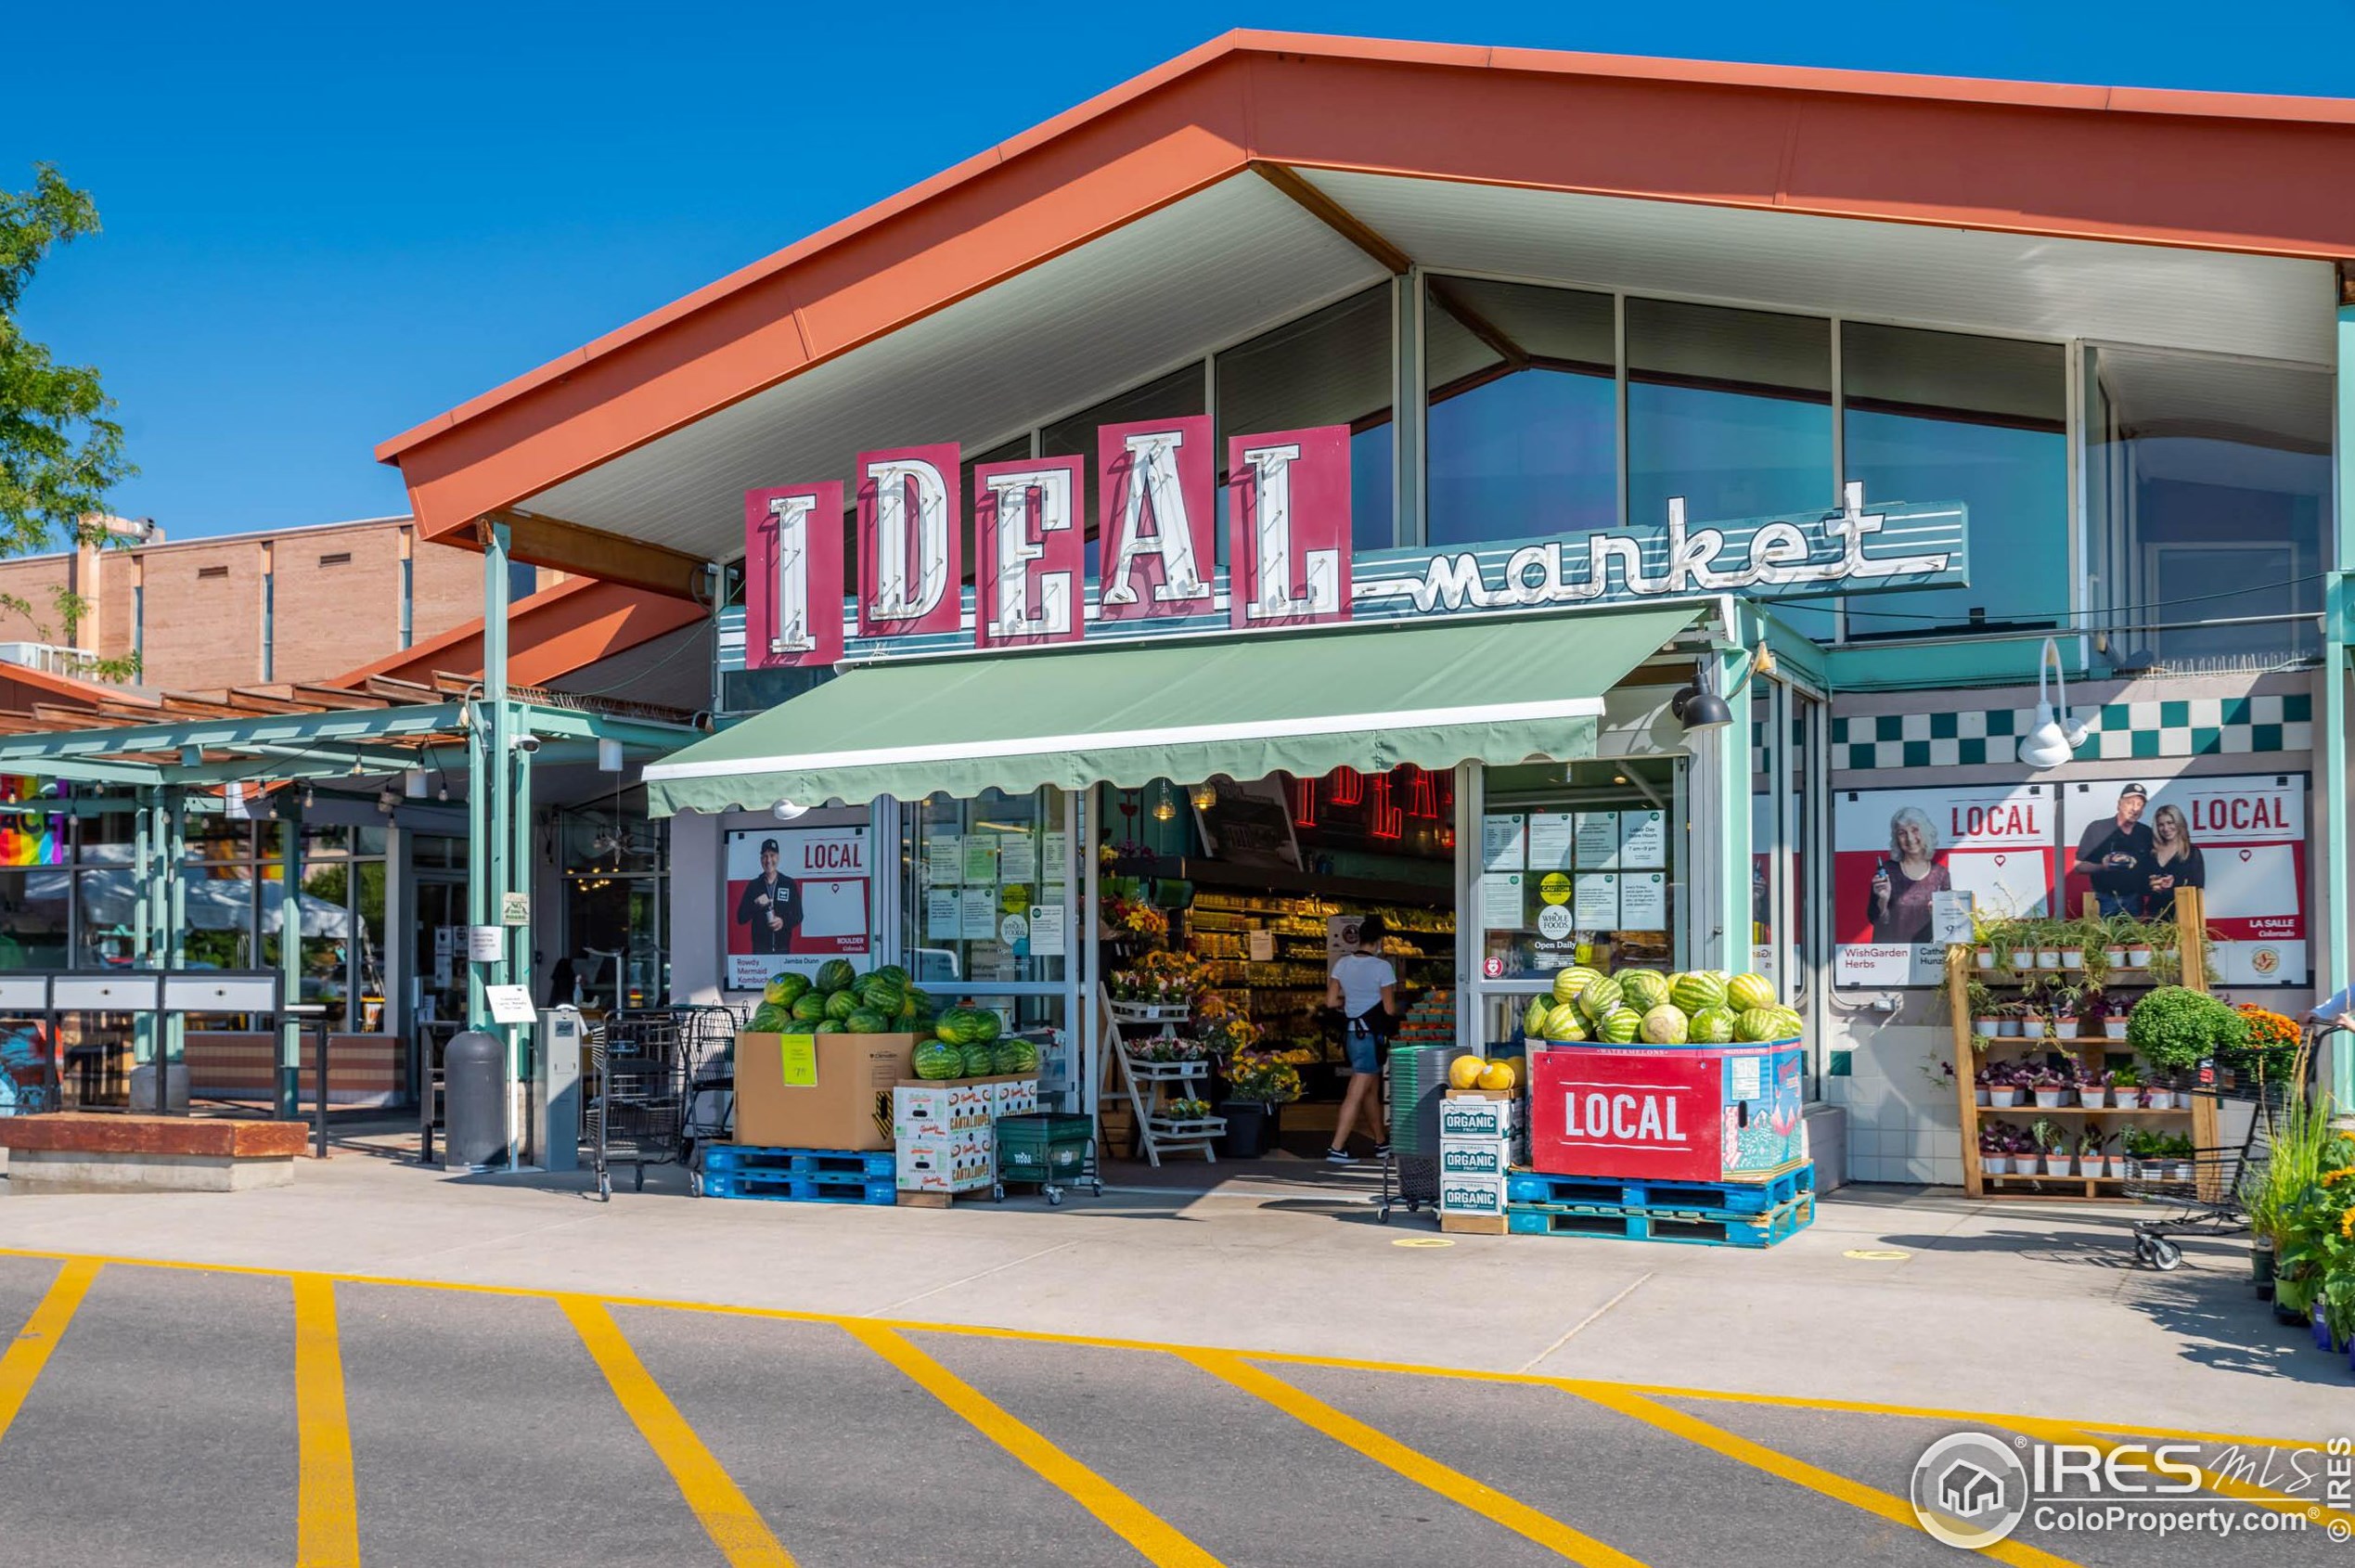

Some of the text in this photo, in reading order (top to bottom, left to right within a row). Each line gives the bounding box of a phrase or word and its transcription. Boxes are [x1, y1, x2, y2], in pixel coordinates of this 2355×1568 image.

[769, 430, 1340, 654] IDEAL
[2193, 797, 2289, 830] LOCAL
[1951, 805, 2040, 836] LOCAL
[804, 843, 862, 868] LOCAL
[1542, 913, 1569, 924] WHOLE
[2265, 919, 2295, 928] SALLE
[1534, 941, 1576, 950] Open Daily
[1920, 947, 1945, 956] Cathe
[1845, 948, 1908, 958] WishGarden
[737, 958, 760, 967] Rowdy
[1845, 959, 1875, 969] Herbs
[1448, 1115, 1495, 1128] ORGANIC
[1565, 1091, 1687, 1141] LOCAL
[1448, 1154, 1495, 1166] ORGANIC
[1448, 1191, 1495, 1204] ORGANIC
